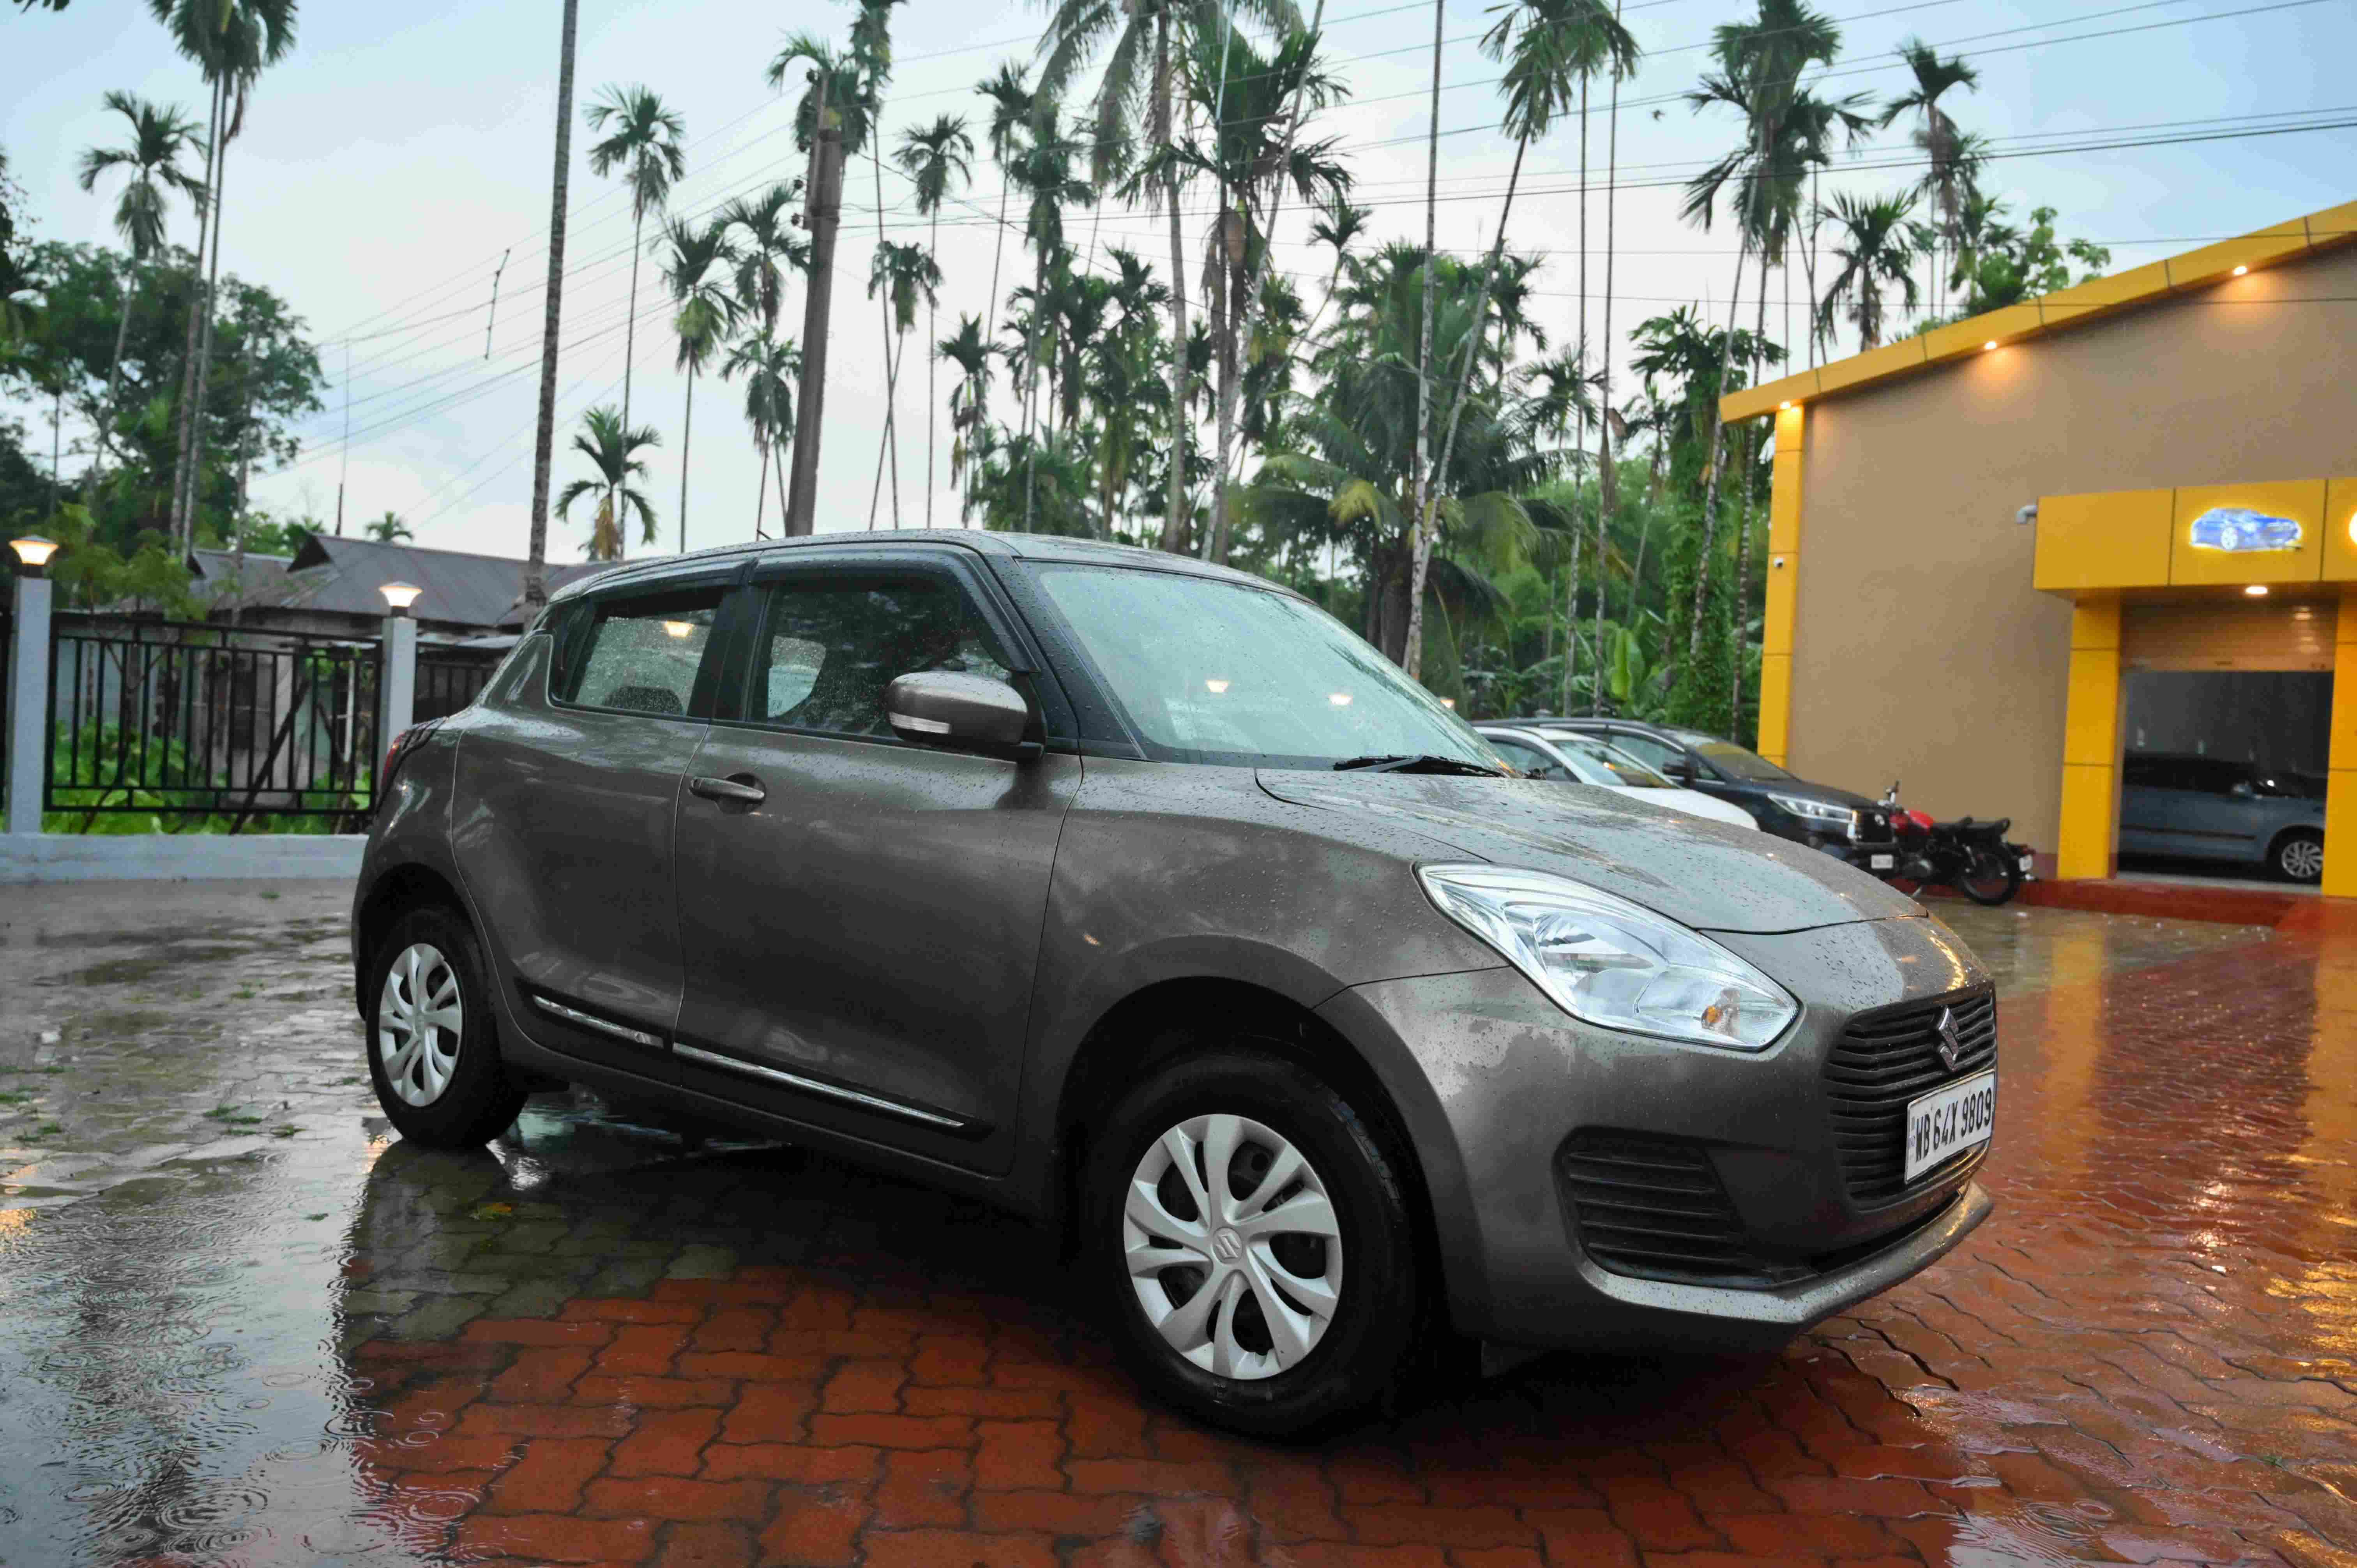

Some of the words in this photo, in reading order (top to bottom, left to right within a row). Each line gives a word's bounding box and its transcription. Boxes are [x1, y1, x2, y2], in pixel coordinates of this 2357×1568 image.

[1915, 1113, 1930, 1163] WB
[1933, 1100, 1958, 1150] 64X
[1961, 1087, 1991, 1137] 9809
